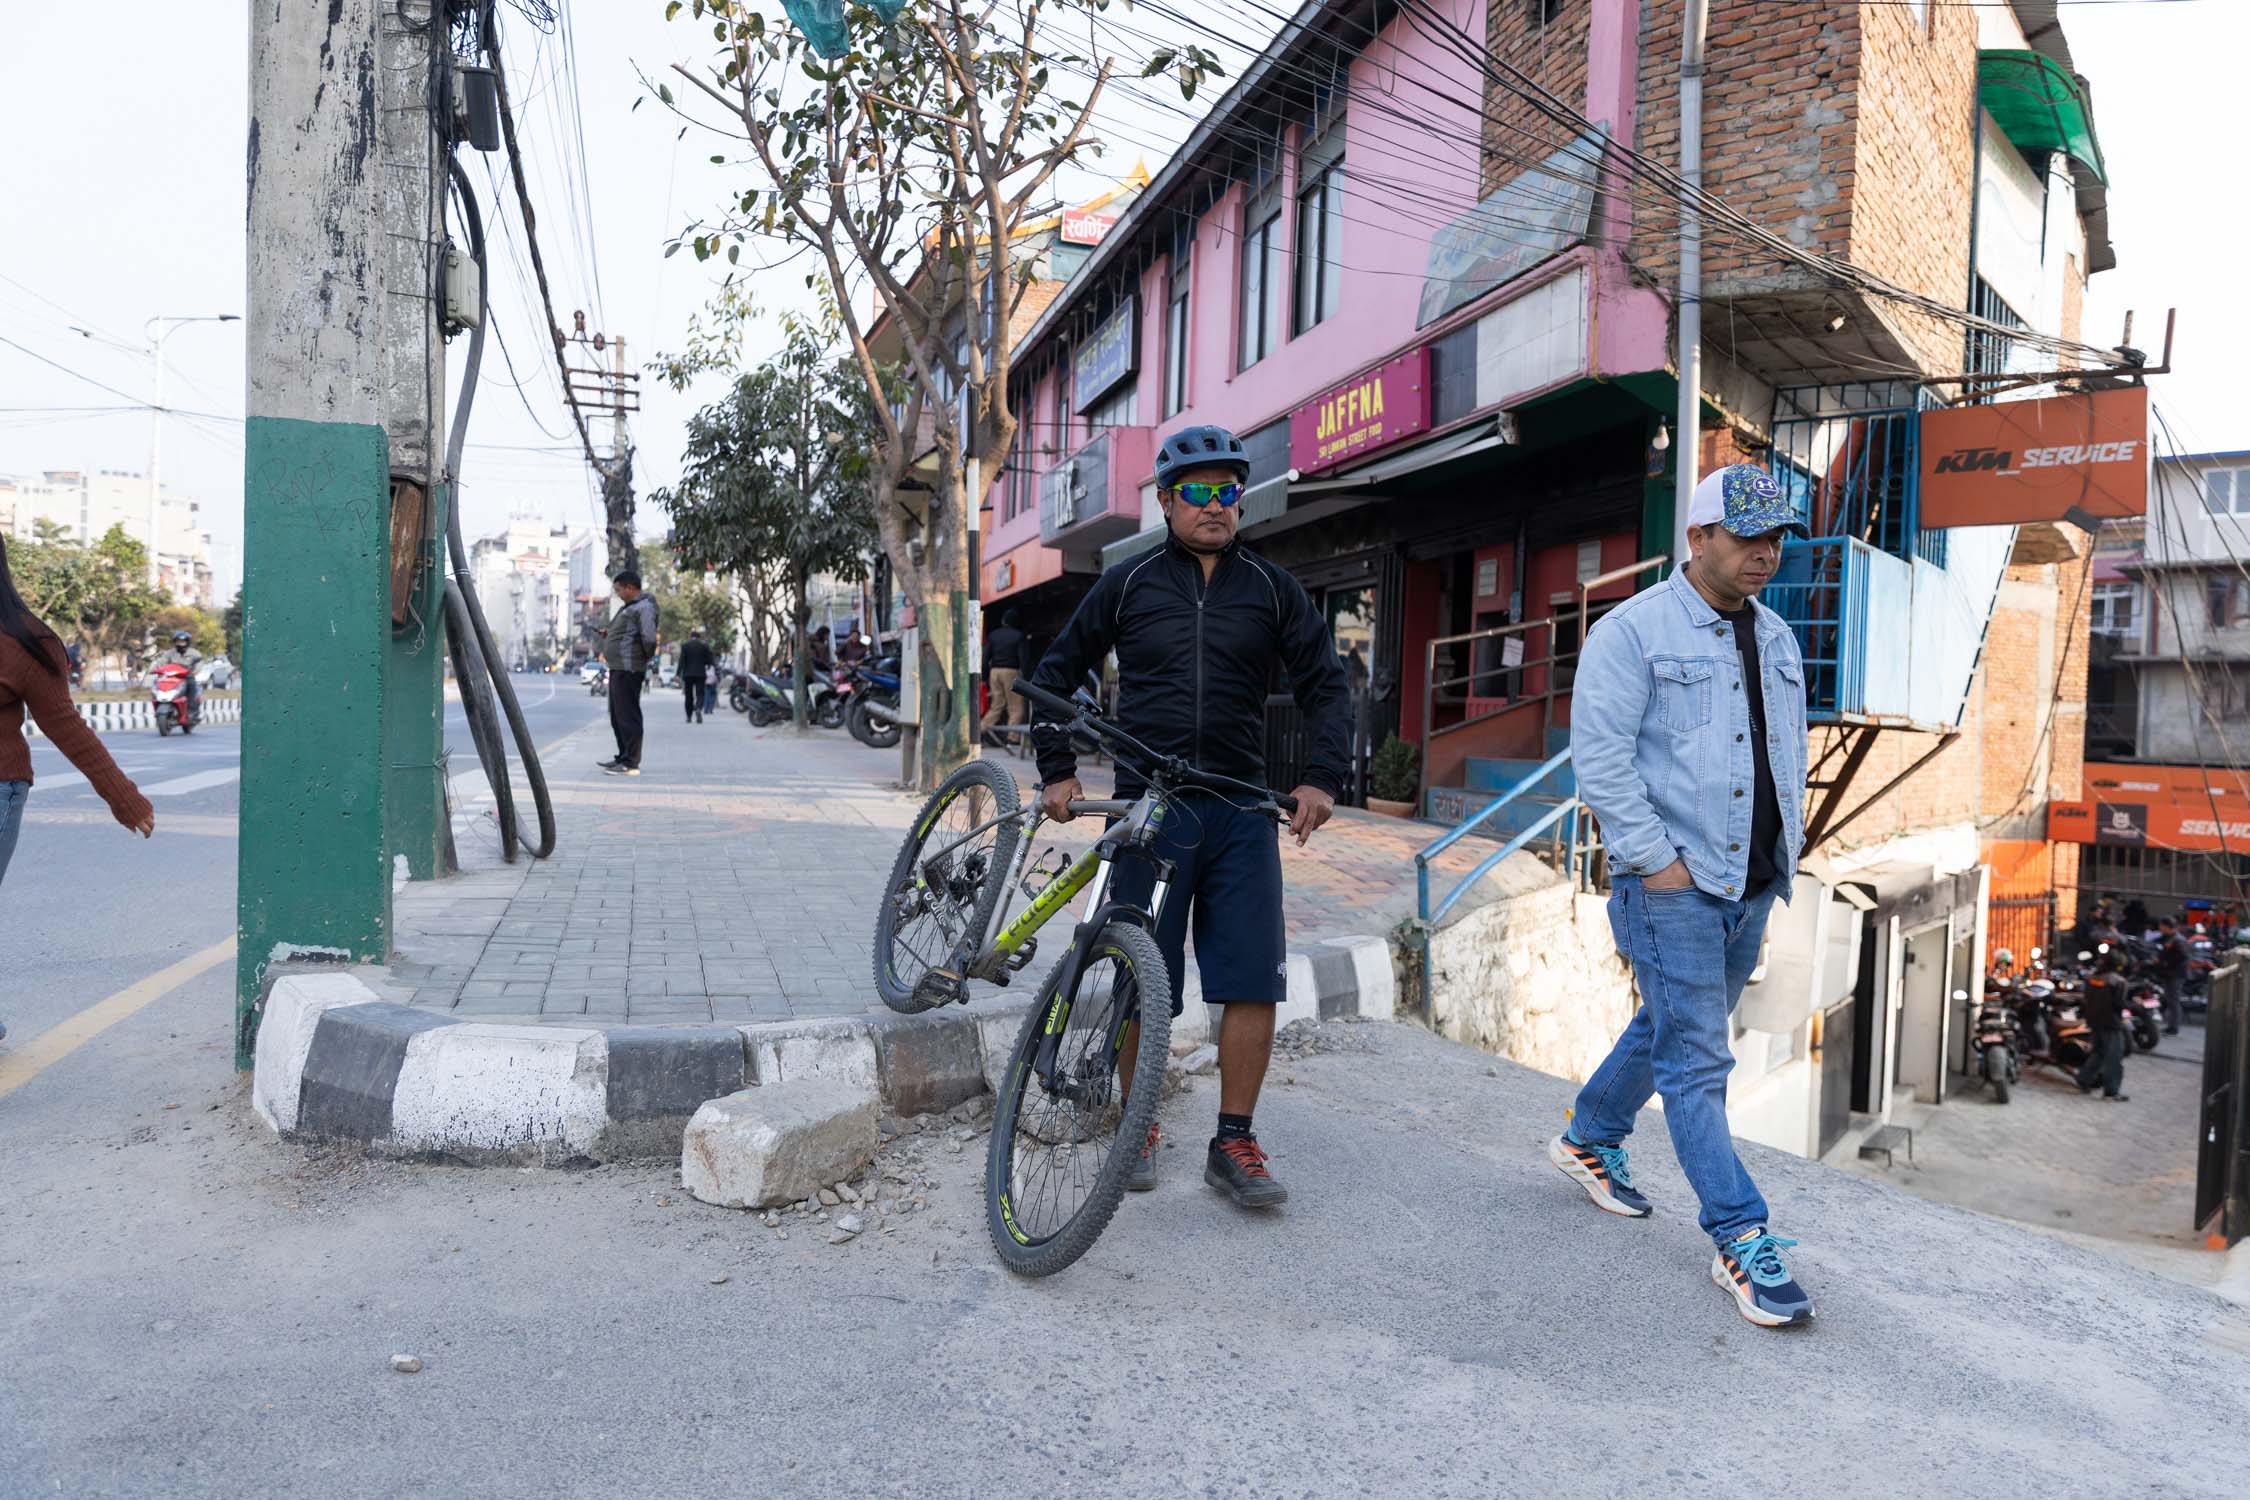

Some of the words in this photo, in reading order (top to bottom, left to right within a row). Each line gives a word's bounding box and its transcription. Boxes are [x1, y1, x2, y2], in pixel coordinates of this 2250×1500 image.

[1317, 378, 1384, 440] JAFFNA
[1935, 447, 2012, 474] KTM
[2020, 441, 2138, 468] SERVICE
